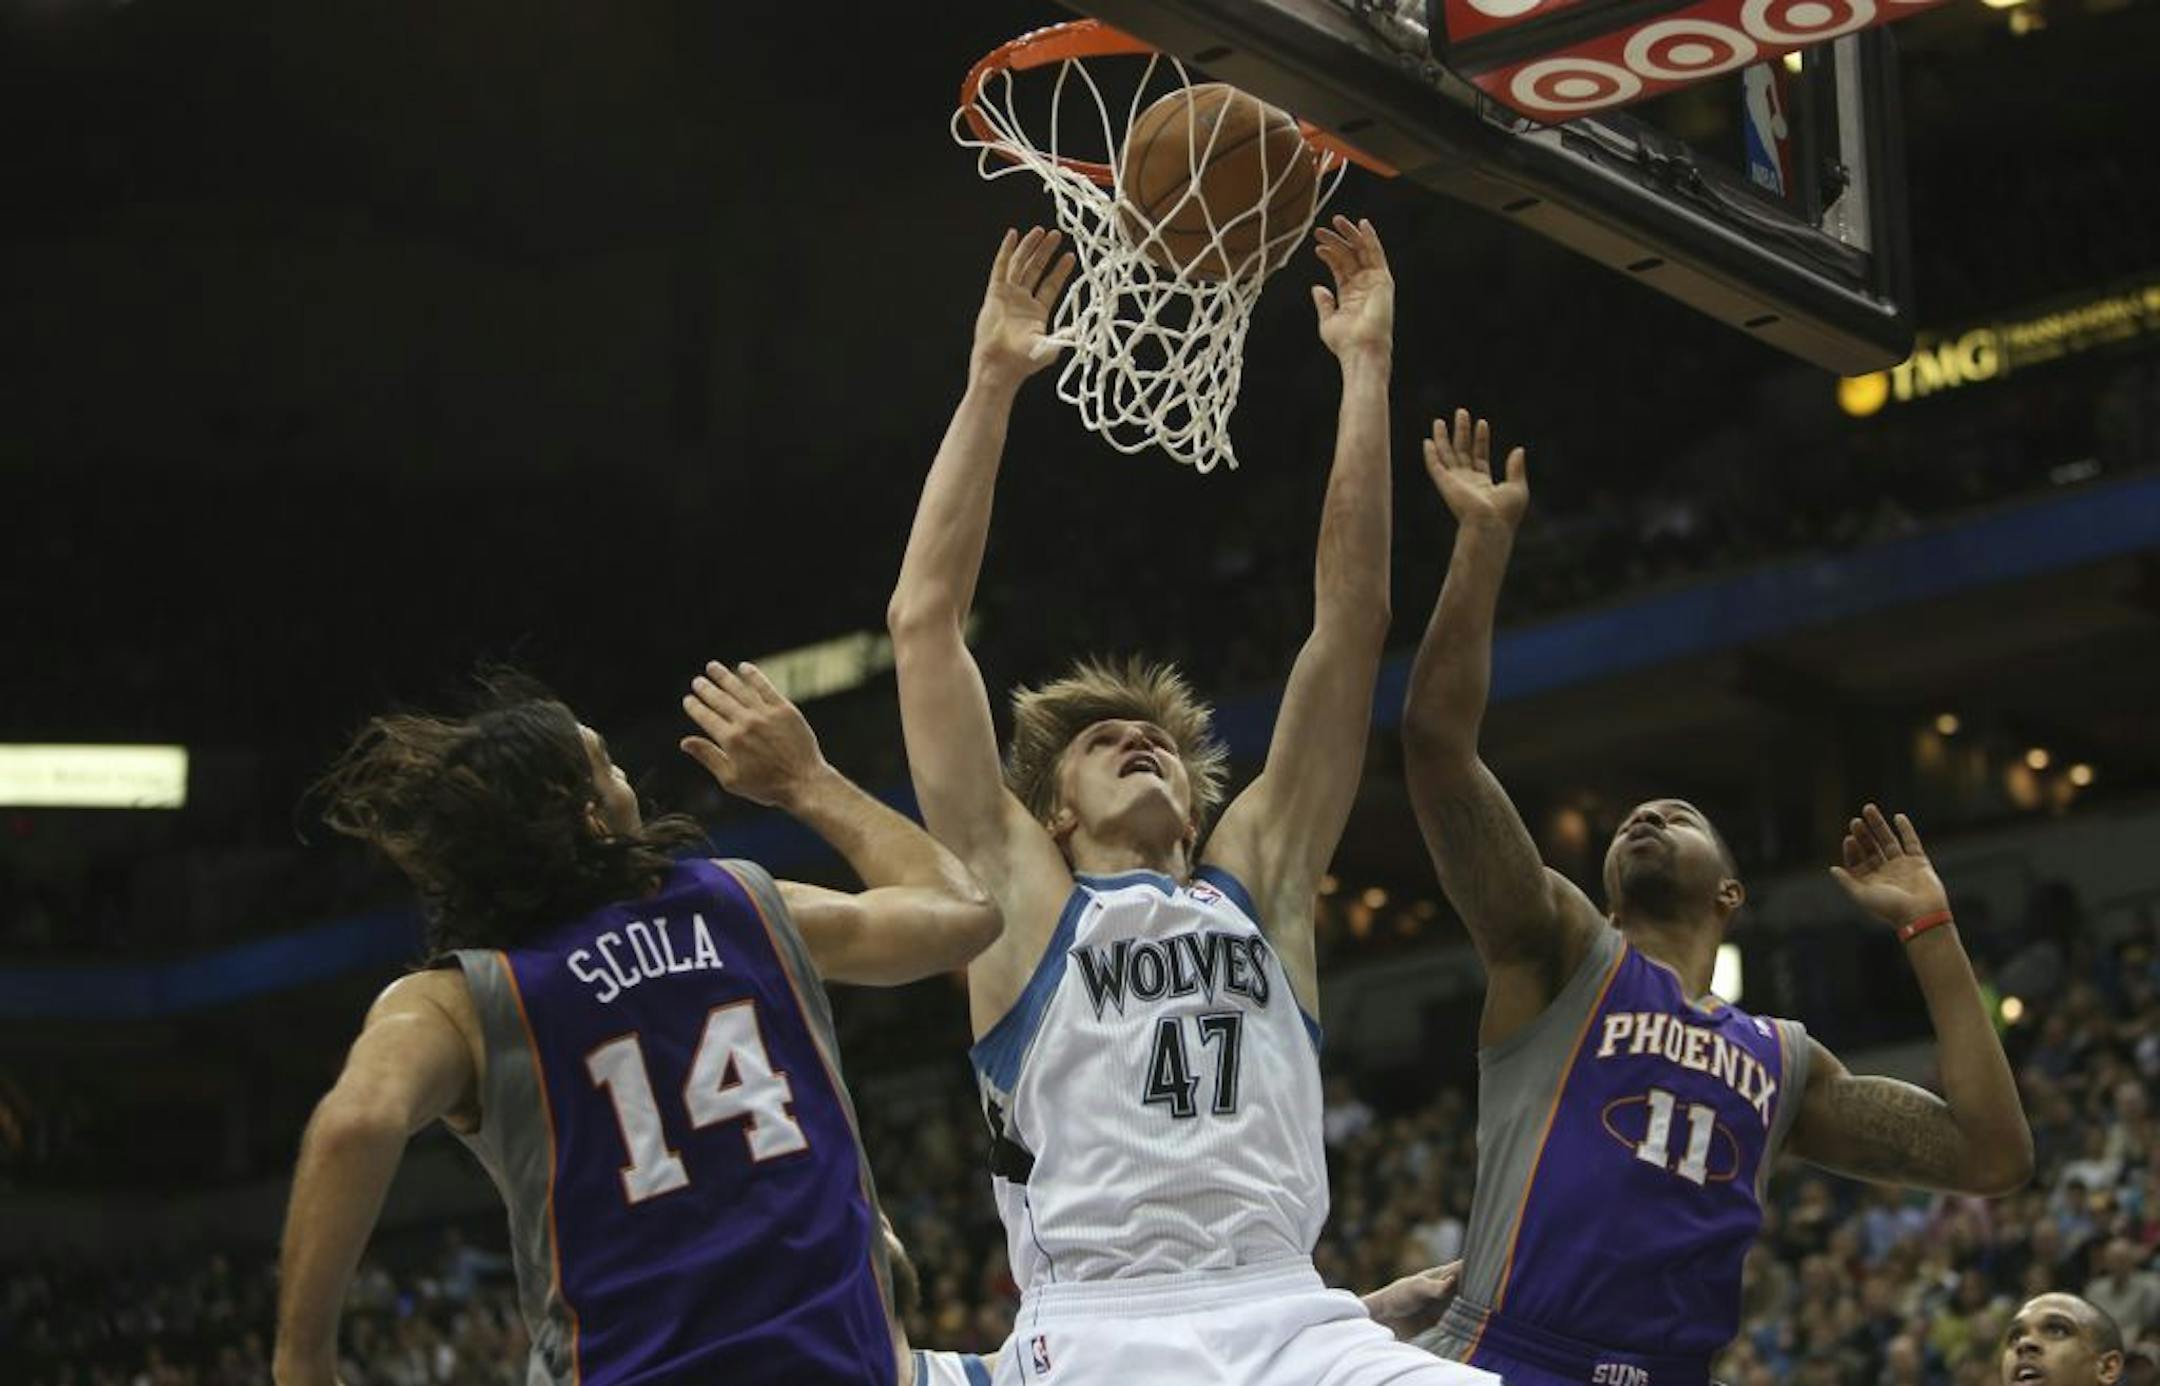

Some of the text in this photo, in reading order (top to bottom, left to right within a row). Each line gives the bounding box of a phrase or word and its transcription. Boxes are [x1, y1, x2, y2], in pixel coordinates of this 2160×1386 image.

[567, 914, 723, 1003] SCOLA
[1069, 932, 1270, 1022] WOLVES
[584, 999, 809, 1204] 14
[1143, 1011, 1244, 1118] 47
[1597, 1012, 1776, 1130] PHOENIX
[1636, 1087, 1717, 1187] 11
